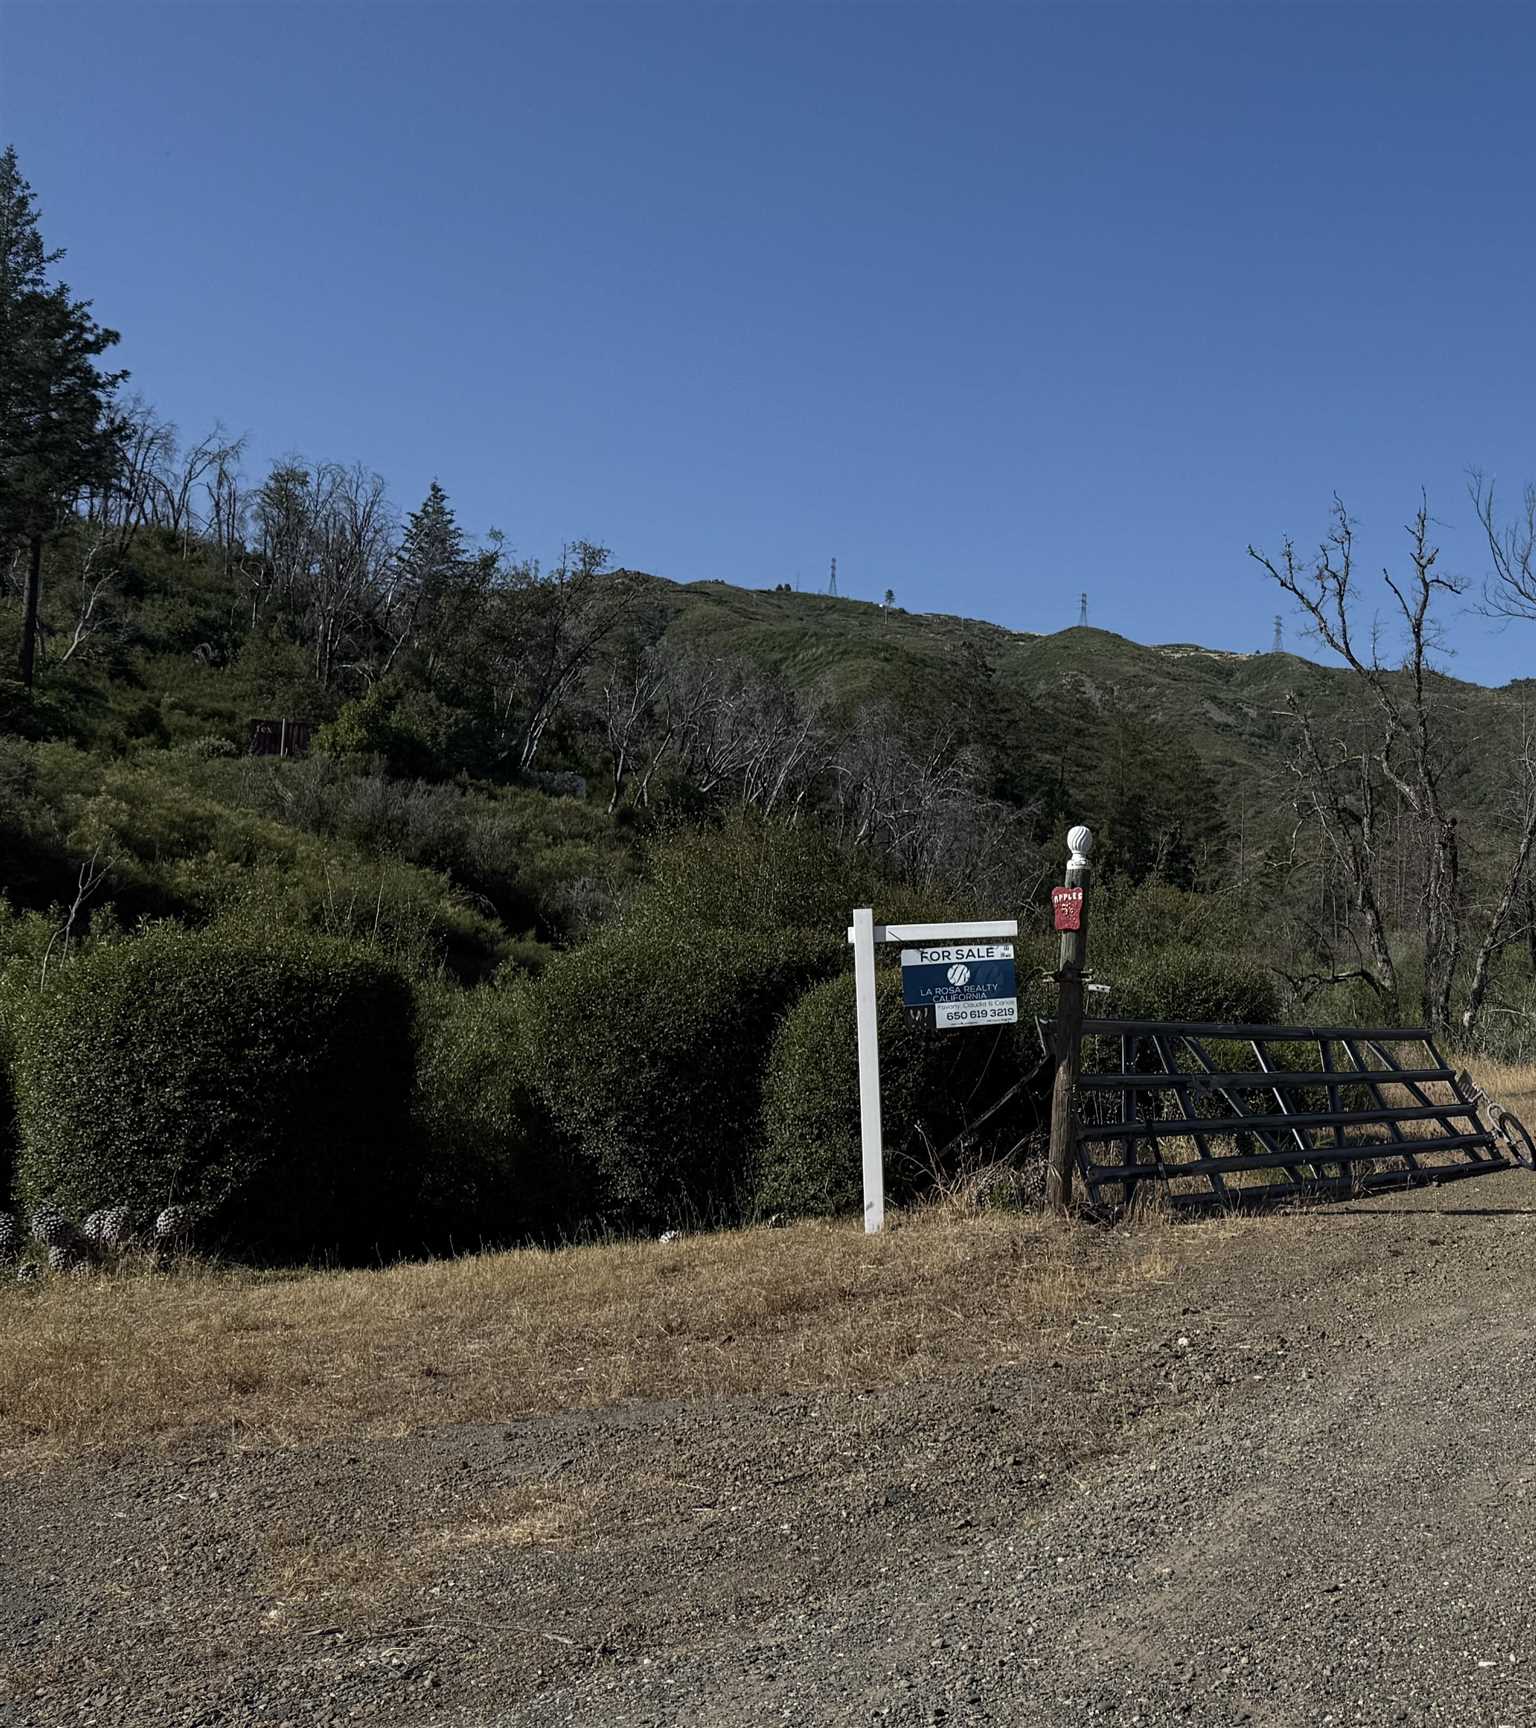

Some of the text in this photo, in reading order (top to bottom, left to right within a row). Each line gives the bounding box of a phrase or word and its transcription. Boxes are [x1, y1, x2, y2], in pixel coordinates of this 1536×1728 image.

[1054, 892, 1083, 903] APPLES
[920, 950, 952, 962] FOR
[955, 947, 995, 960] SALE
[920, 983, 998, 996] LA ROSA REALTY
[932, 992, 988, 1003] CALIFORNIA
[946, 1007, 1015, 1021] 650 619 3219
